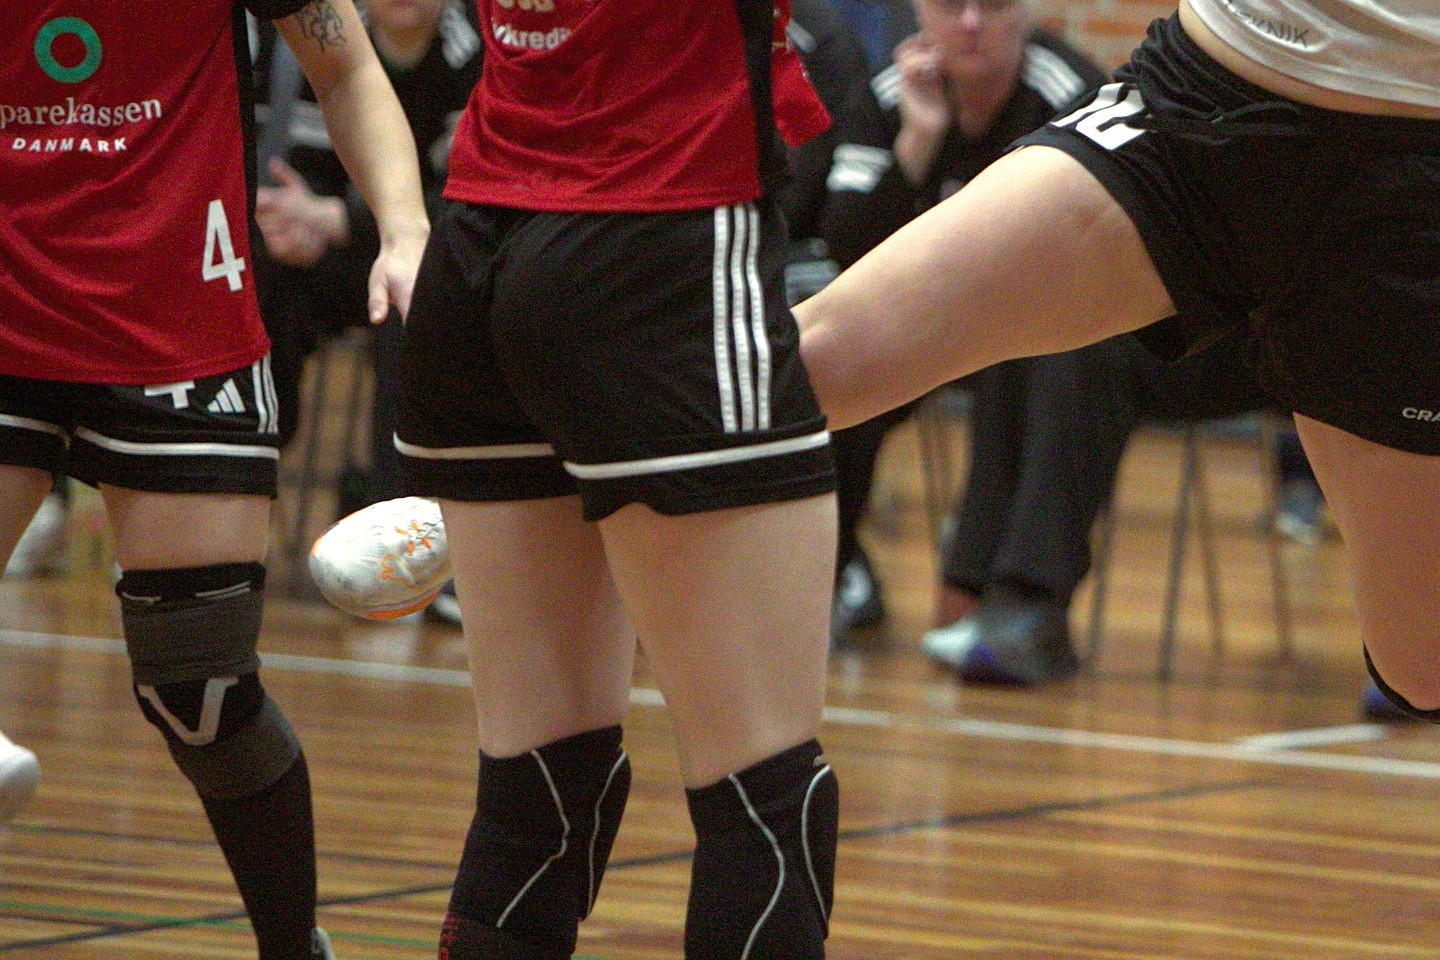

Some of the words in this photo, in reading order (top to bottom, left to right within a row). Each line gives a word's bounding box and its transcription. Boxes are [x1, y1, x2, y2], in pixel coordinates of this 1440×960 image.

[0, 96, 163, 130] parekassen
[12, 137, 128, 153] DANMARK
[202, 198, 247, 292] 4
